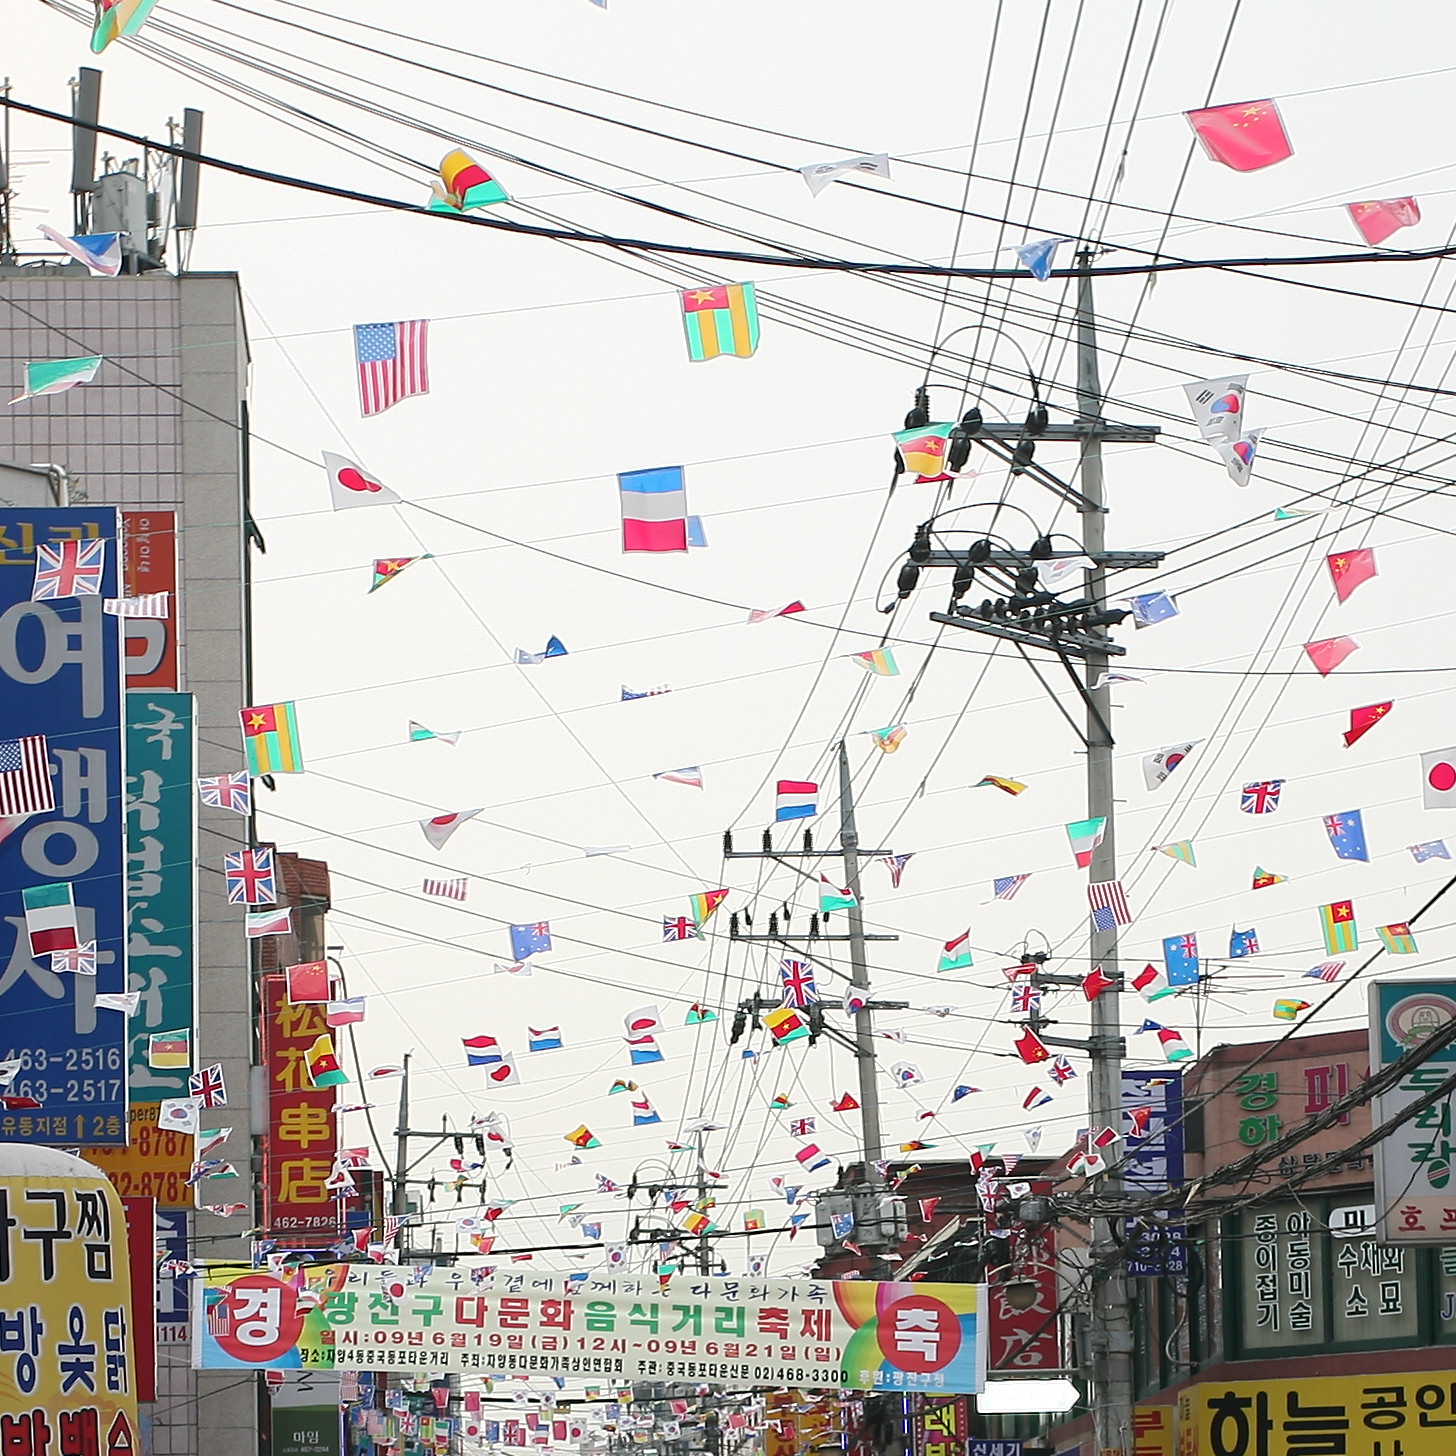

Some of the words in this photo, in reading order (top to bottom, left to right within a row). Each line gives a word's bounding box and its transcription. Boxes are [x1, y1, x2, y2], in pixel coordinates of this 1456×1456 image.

[92, 1116, 122, 1139] 2층
[1254, 1213, 1280, 1331] 종이접기
[1286, 1210, 1313, 1331] 아동미술
[690, 1281, 829, 1305] 다문화가족
[1344, 1280, 1403, 1319] 소묘
[233, 1286, 282, 1346] 경
[455, 1296, 575, 1333] 다문화
[584, 1299, 746, 1339] 음식거리
[757, 1306, 834, 1343] 축제
[893, 1308, 941, 1363] 축
[754, 1366, 849, 1384] 02)468-3300
[293, 1432, 320, 1444] 마임
